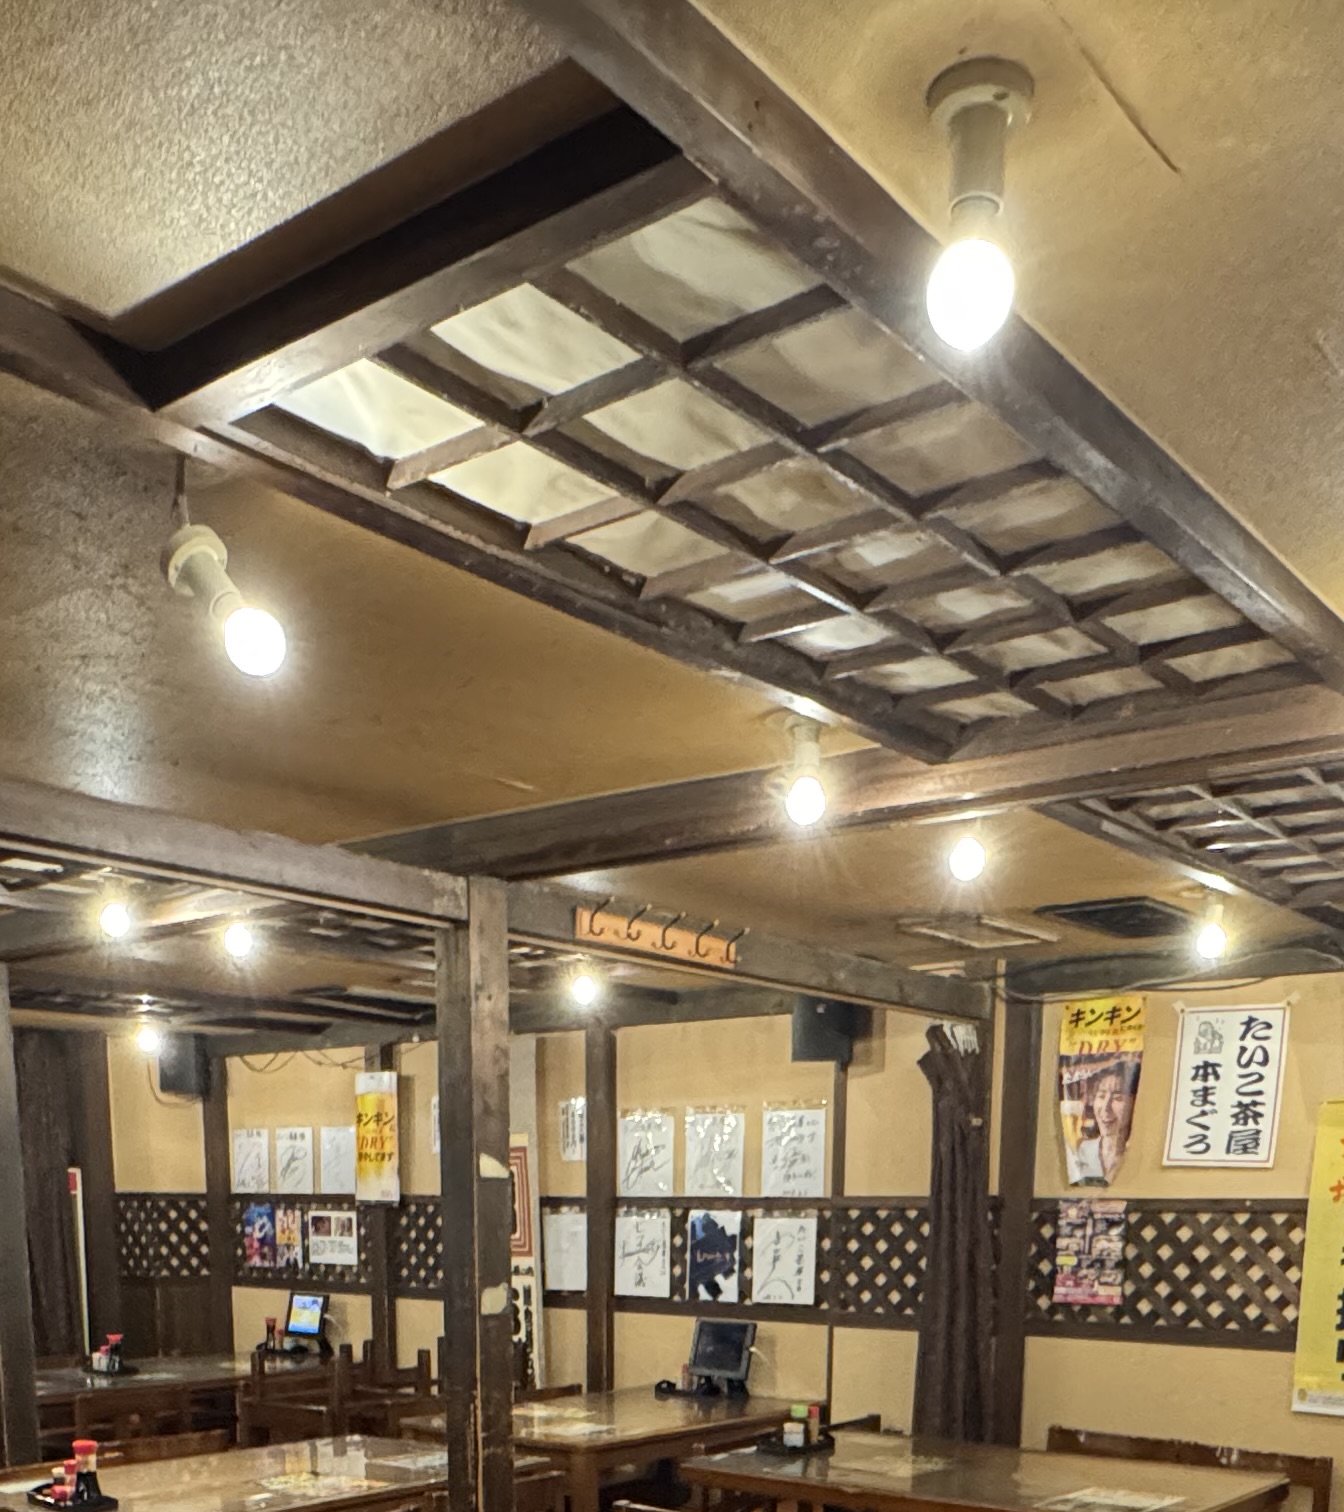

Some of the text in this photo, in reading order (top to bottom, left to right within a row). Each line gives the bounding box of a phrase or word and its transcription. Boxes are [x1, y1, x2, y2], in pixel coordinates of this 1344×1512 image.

[1069, 1006, 1141, 1028] キンキン
[1183, 1061, 1222, 1155] 本まぐろ
[1225, 1015, 1273, 1156] たいこ茶屋
